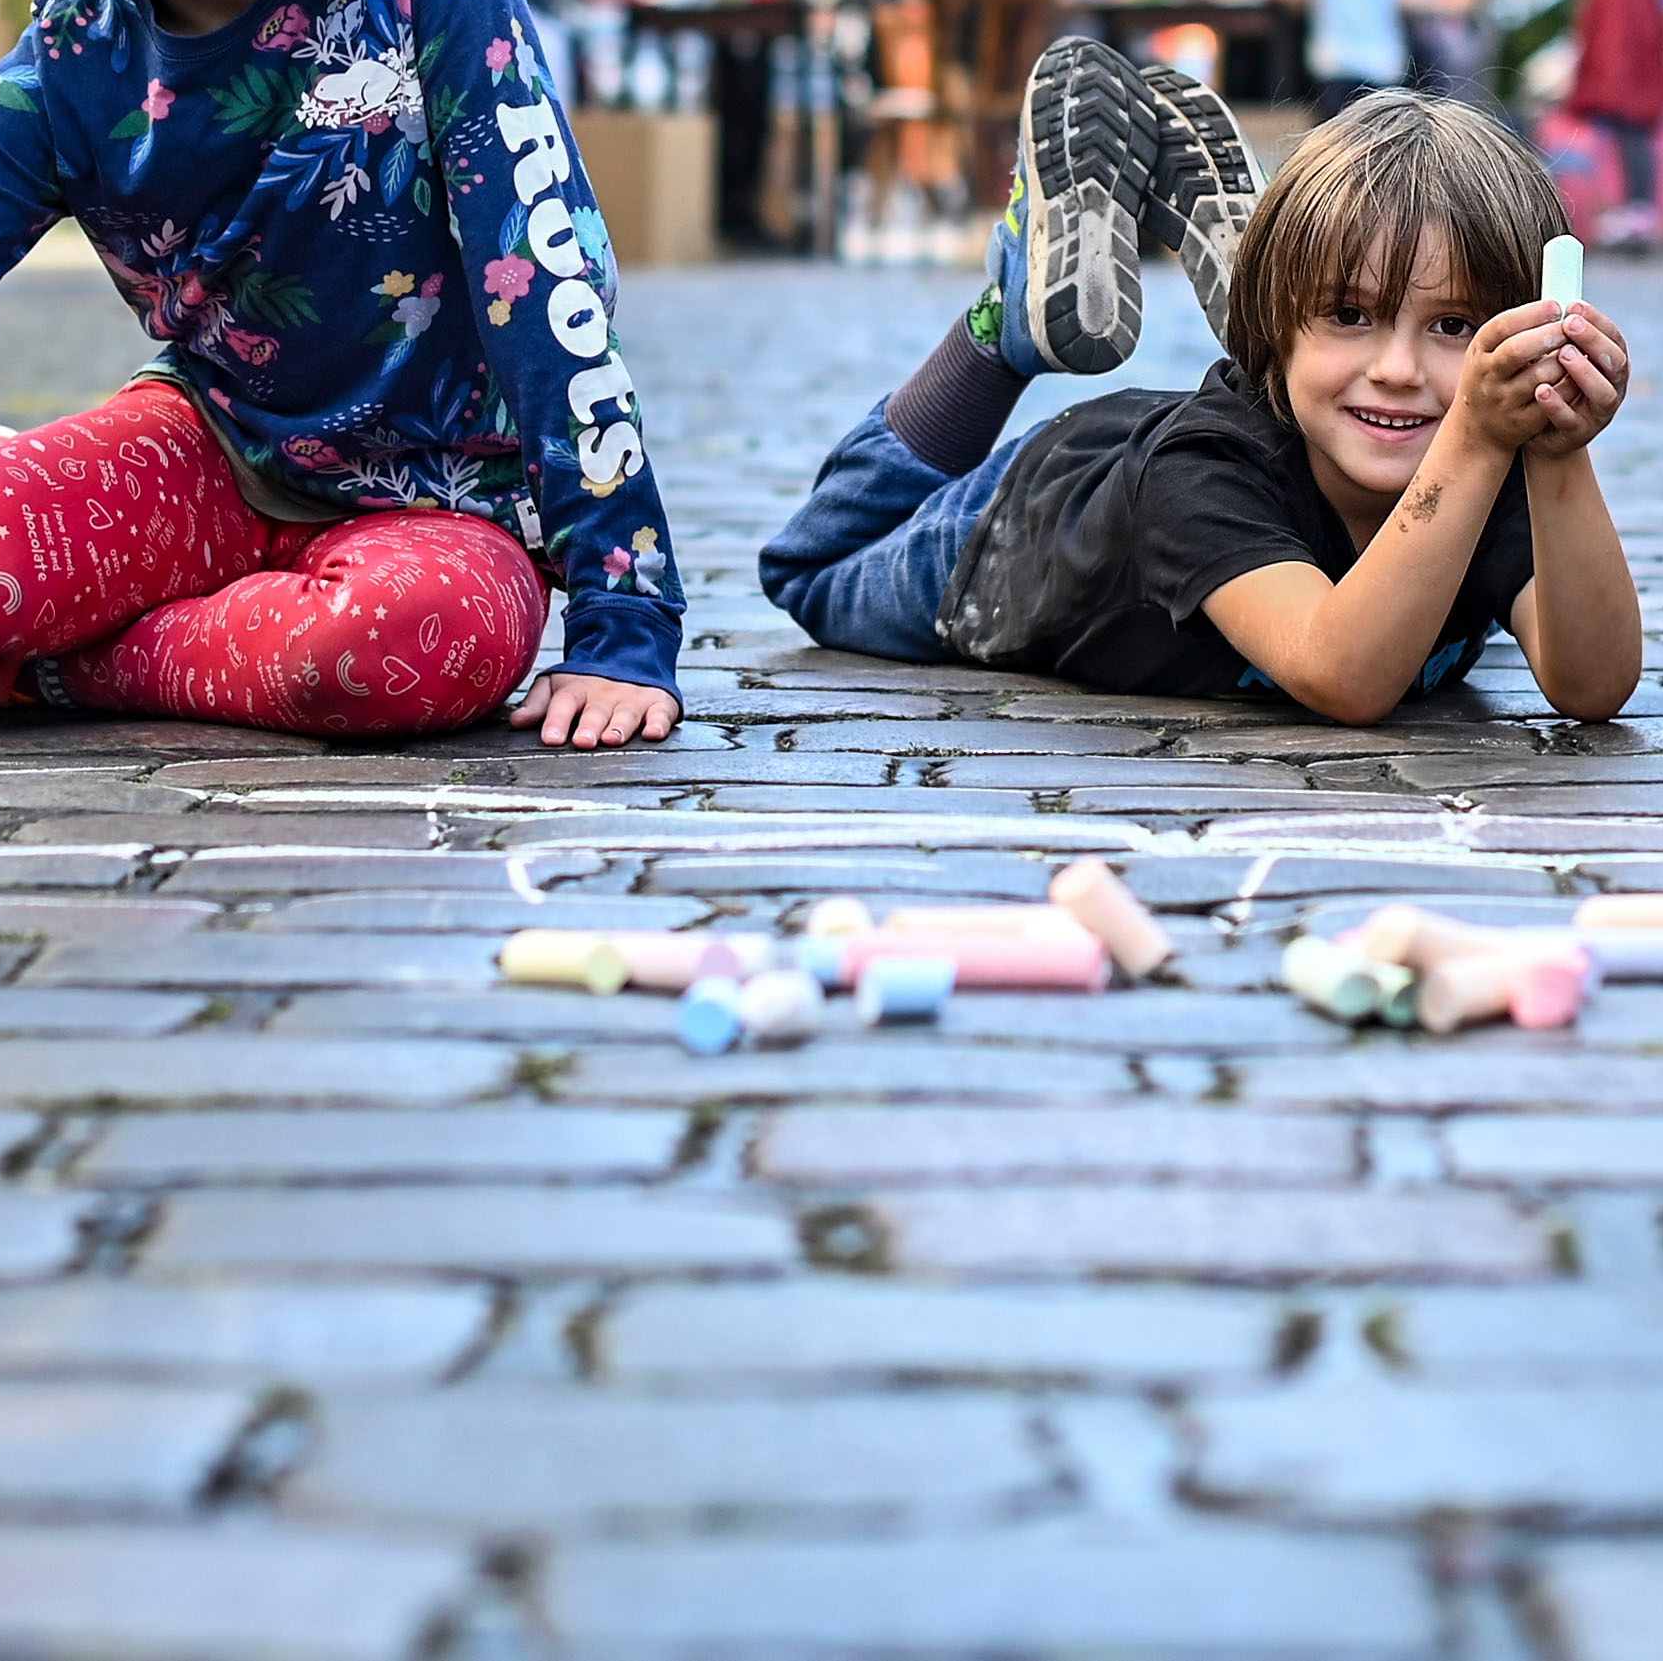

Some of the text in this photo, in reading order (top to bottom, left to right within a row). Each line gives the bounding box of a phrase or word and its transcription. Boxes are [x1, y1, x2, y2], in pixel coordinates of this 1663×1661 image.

[495, 93, 645, 485] ROOTS
[22, 457, 64, 492] MEOW!
[54, 508, 66, 533] love
[144, 505, 166, 542] HAVE
[21, 503, 49, 582] chocolate
[41, 512, 62, 572] music and
[368, 559, 398, 586] FUN!
[385, 565, 426, 601] HAVE
[285, 611, 317, 652] MEOW!
[440, 640, 461, 677] COOL
[448, 641, 475, 680] SUPER
